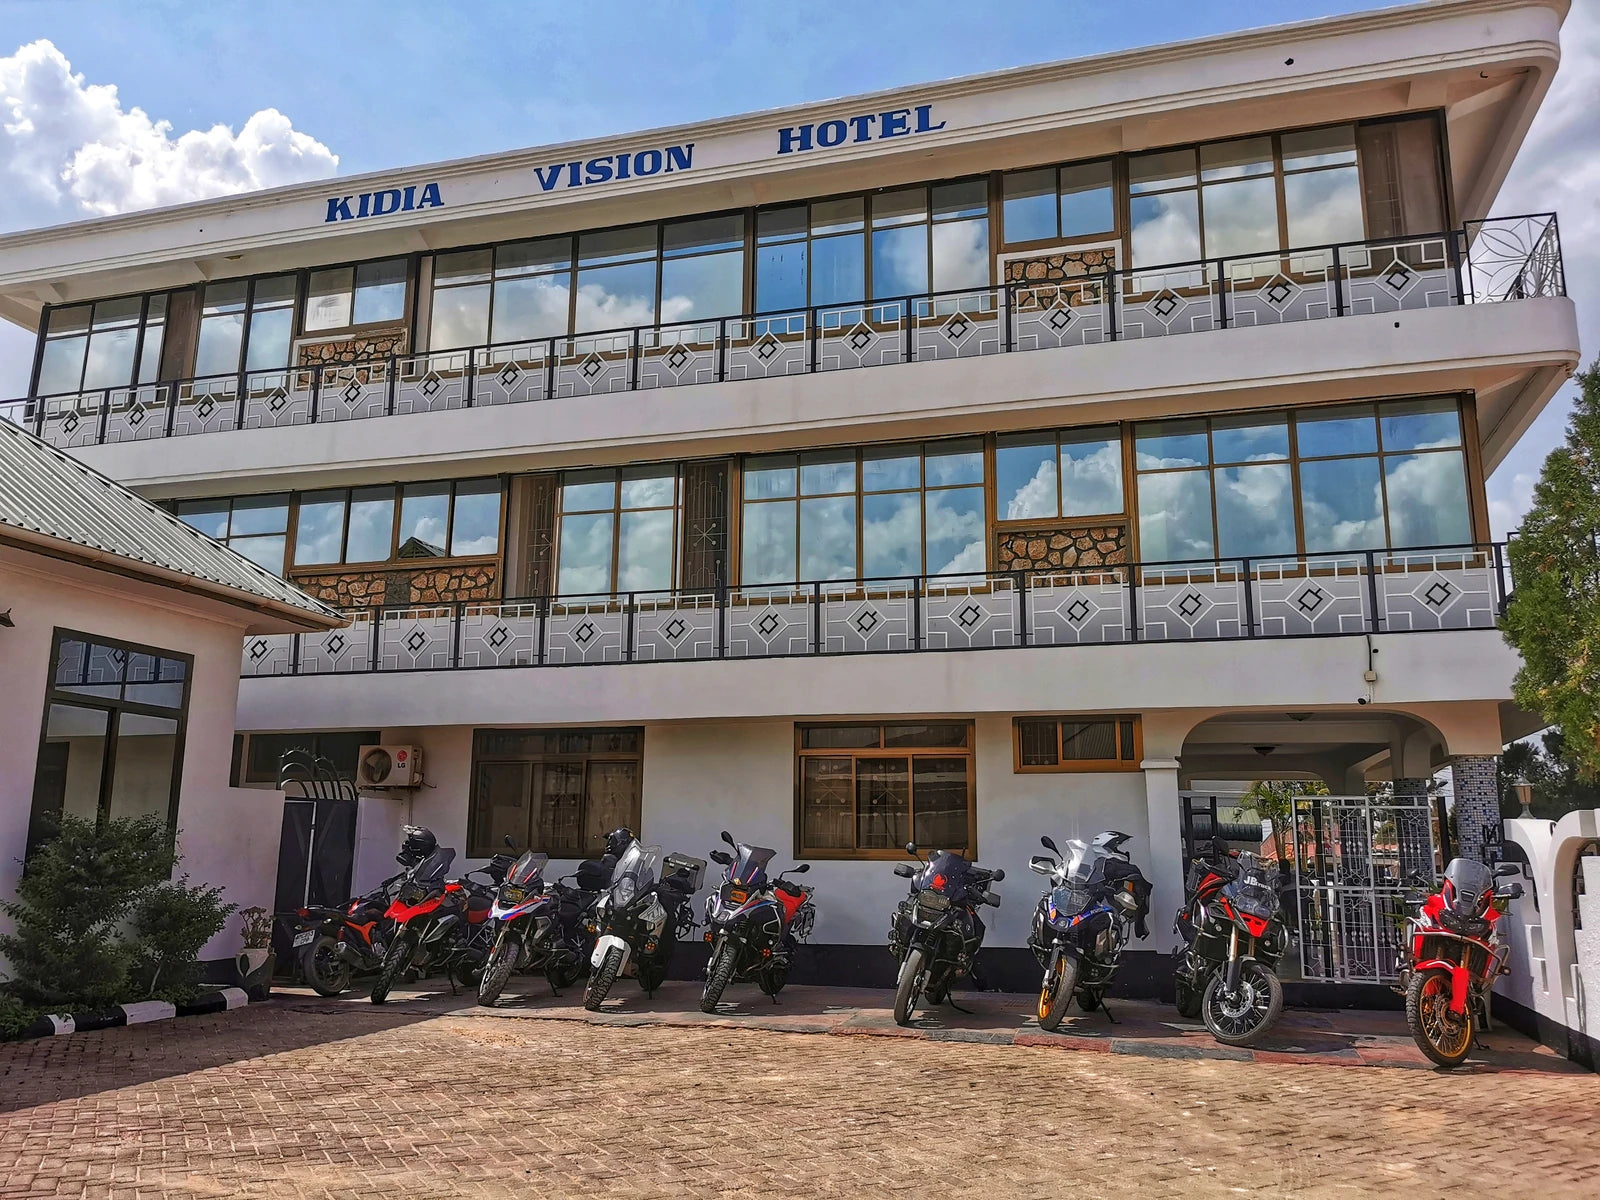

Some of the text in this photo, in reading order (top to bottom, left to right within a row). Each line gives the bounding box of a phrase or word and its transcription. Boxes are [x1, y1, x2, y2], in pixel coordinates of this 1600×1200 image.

[325, 105, 946, 223] KIDIA VISION HOTEL
